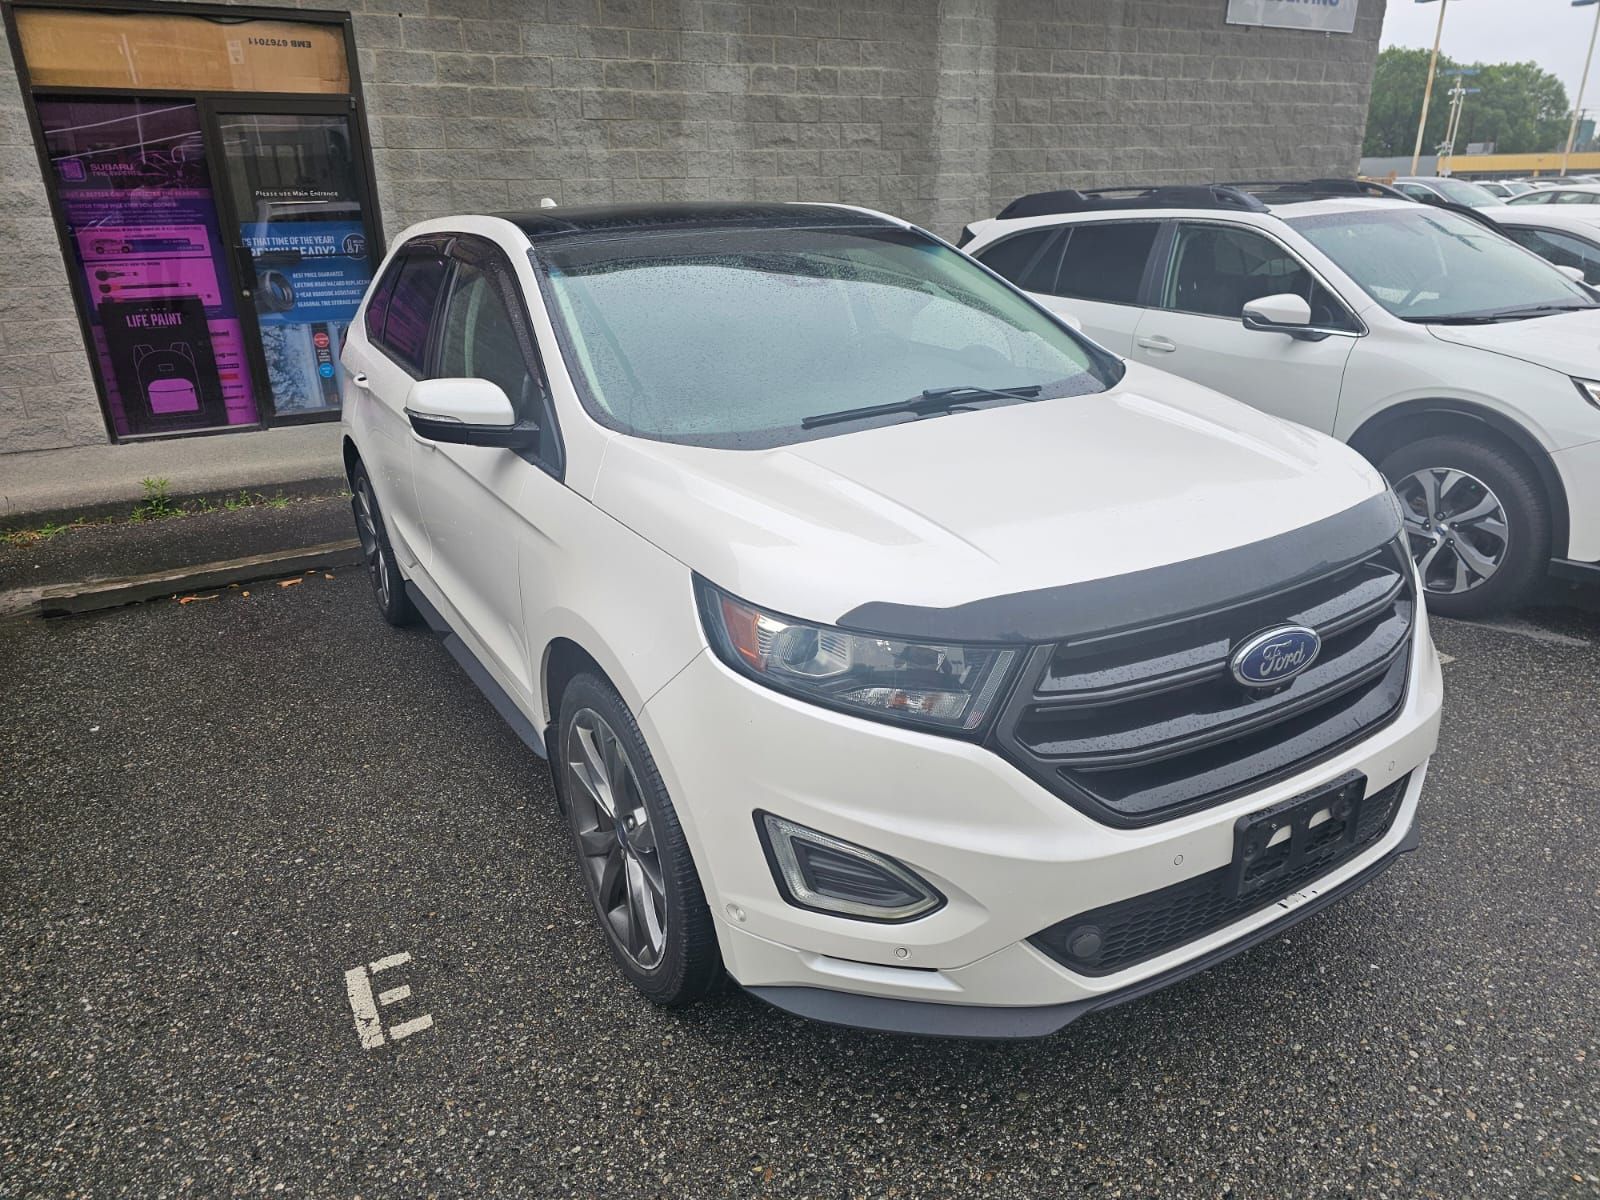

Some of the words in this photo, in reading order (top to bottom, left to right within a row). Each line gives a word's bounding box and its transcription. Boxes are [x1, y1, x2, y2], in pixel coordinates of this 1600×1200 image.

[248, 37, 288, 47] 6767011
[290, 40, 312, 48] EMB
[90, 163, 135, 171] SUBARU
[252, 237, 271, 246] THAT
[271, 237, 289, 246] TIME
[289, 236, 299, 245] OF
[299, 236, 313, 245] THE
[313, 235, 335, 245] YEAR!
[126, 313, 150, 328] LIFE
[150, 312, 182, 326] PAINT
[1260, 640, 1306, 676] Ford
[345, 951, 434, 1050] E
